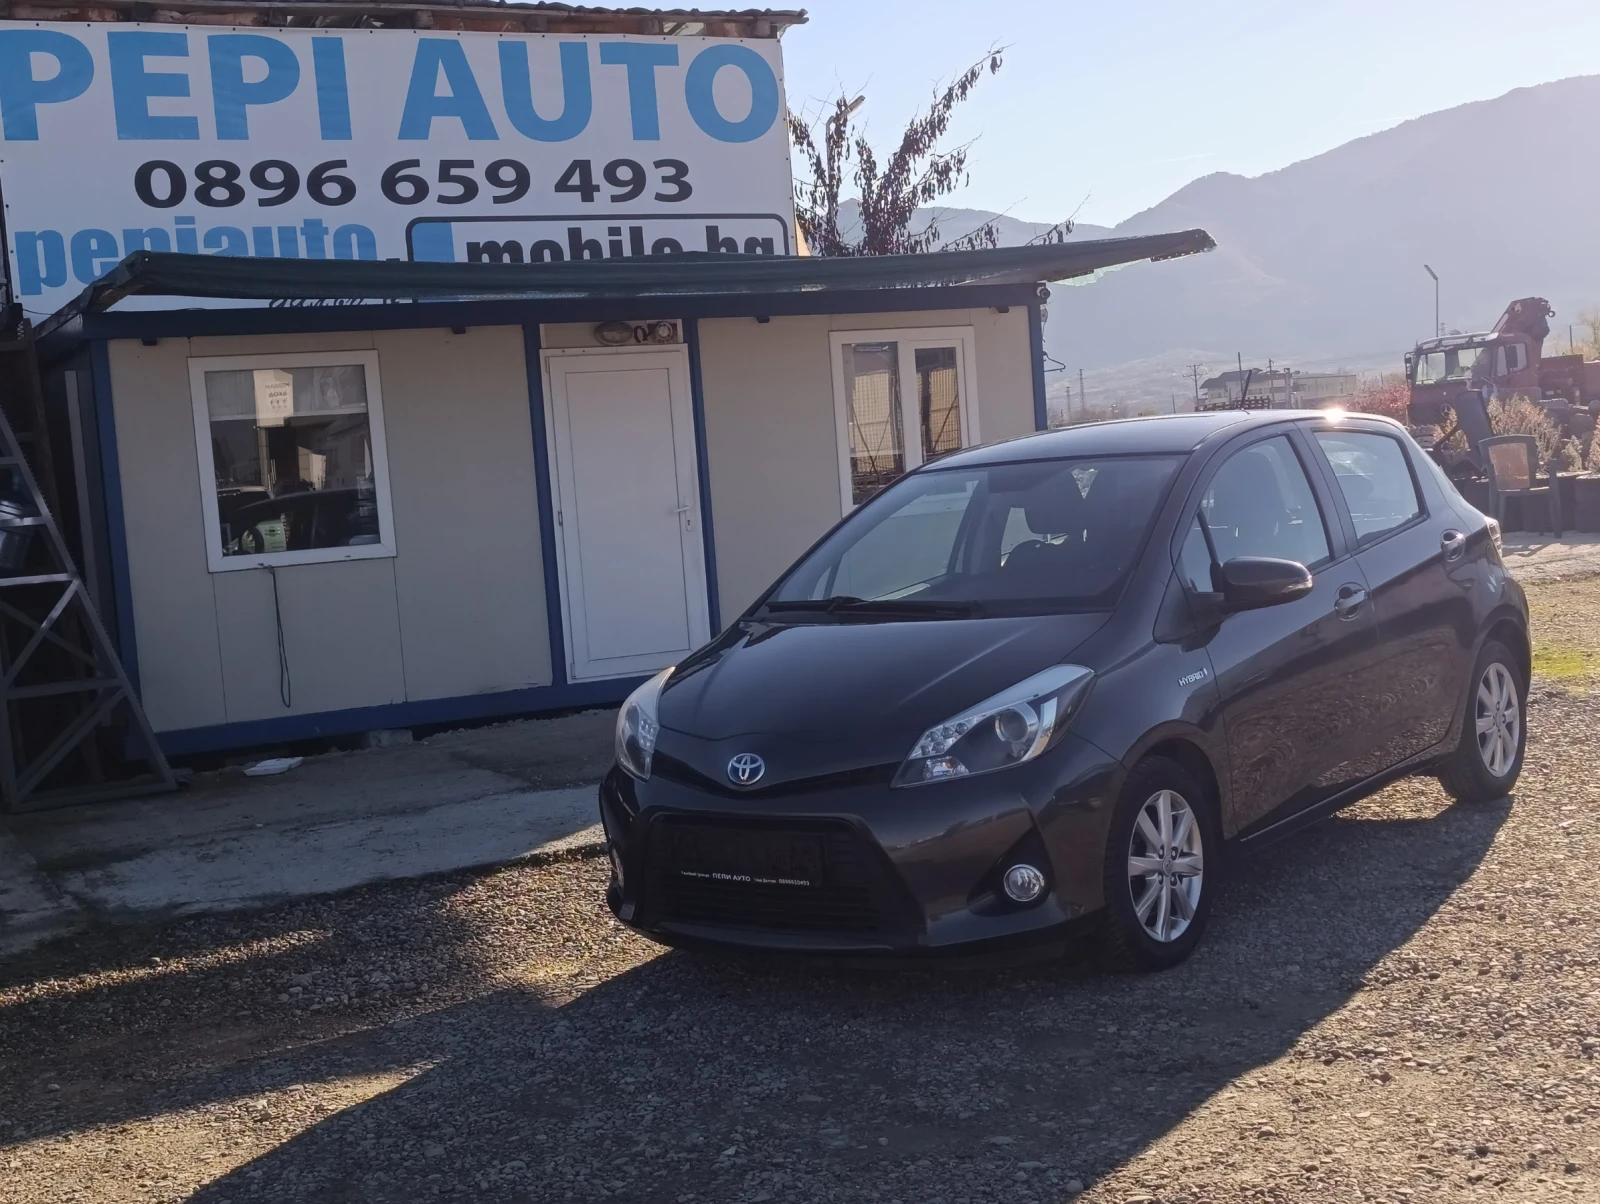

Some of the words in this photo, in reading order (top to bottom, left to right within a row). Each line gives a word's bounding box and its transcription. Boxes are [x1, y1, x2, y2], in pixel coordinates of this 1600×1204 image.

[0, 29, 353, 141] PEPI
[397, 38, 778, 143] AUTO
[134, 159, 357, 209] 0896
[380, 158, 531, 206] 659
[554, 158, 693, 203] 493
[1178, 671, 1205, 687] HYBRID
